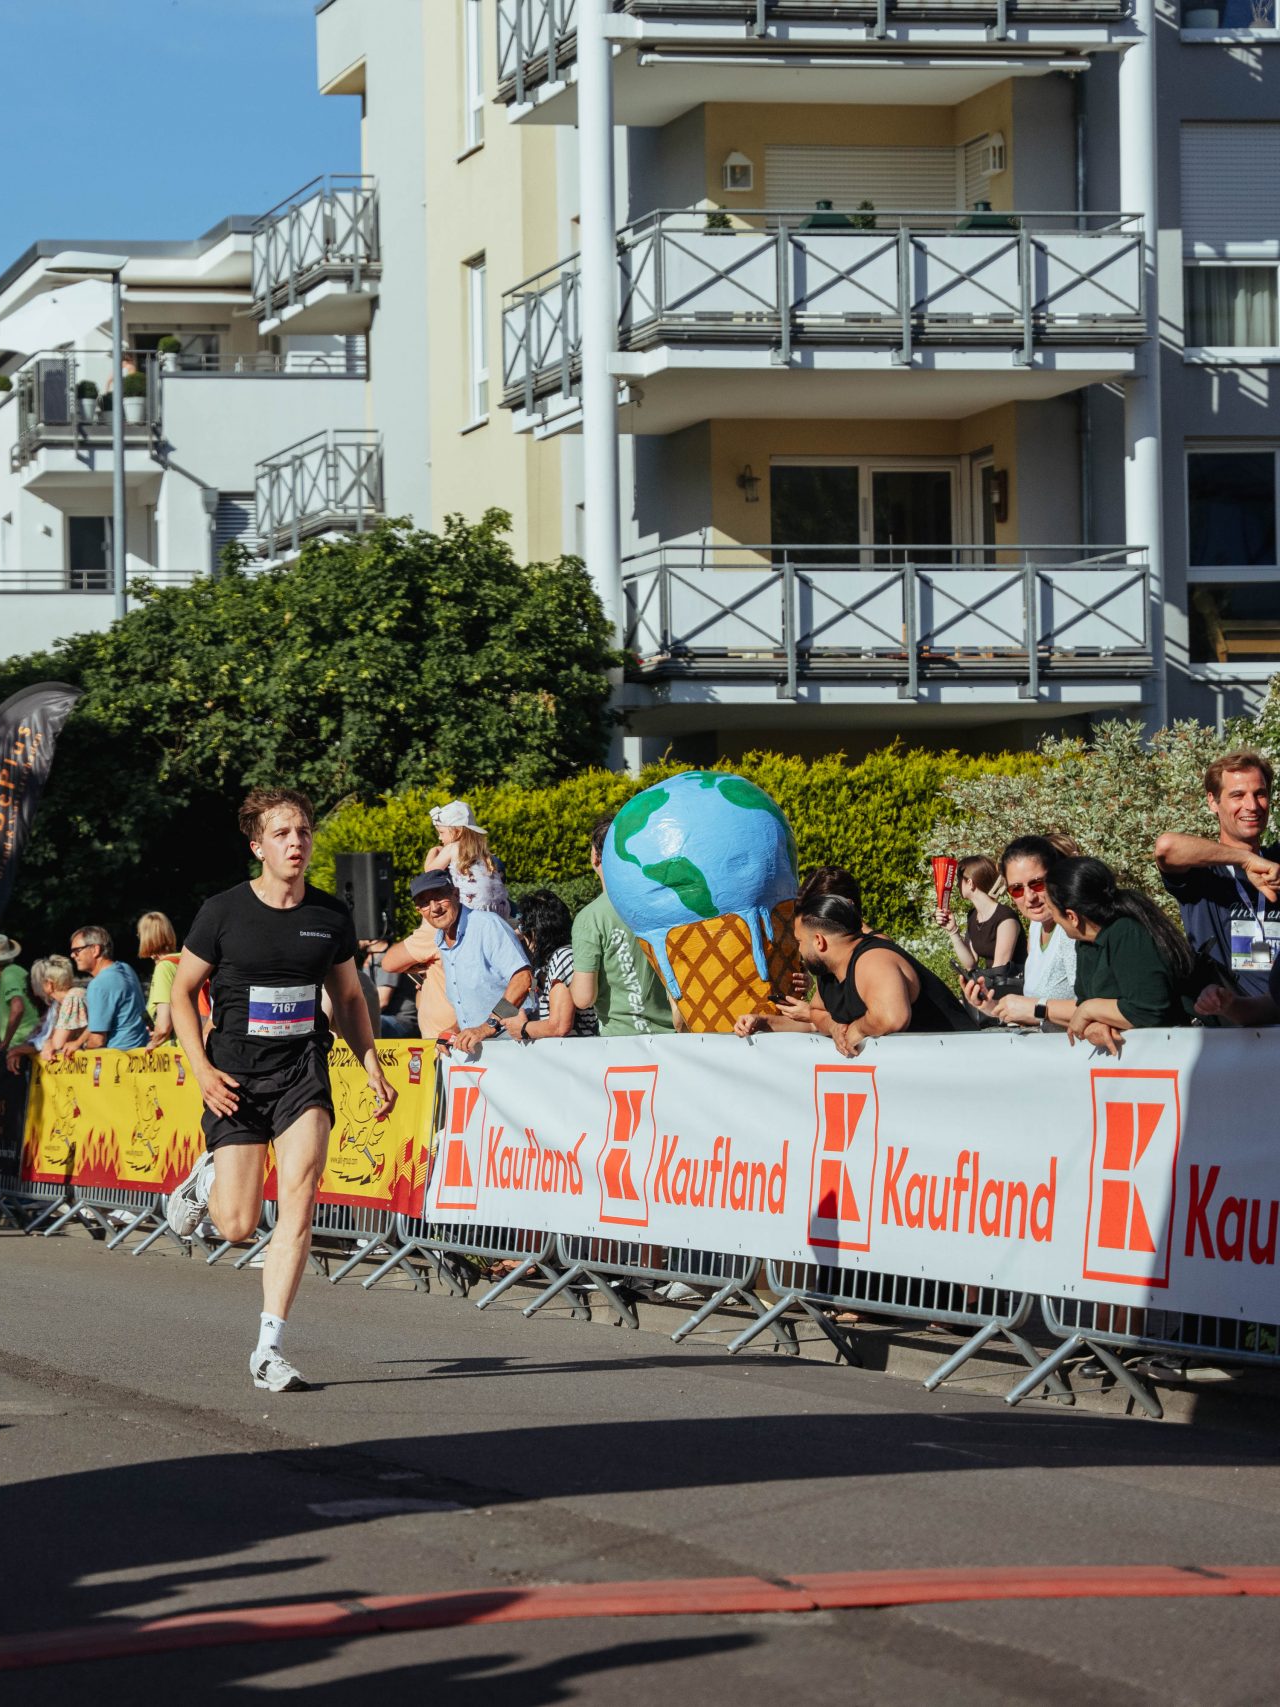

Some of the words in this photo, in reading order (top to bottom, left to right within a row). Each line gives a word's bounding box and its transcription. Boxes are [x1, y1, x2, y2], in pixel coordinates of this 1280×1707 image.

[271, 1003, 297, 1014] 7167
[486, 1127, 586, 1195] Kaufland
[654, 1136, 788, 1214] Kaufland
[882, 1146, 1056, 1242] Kaufland
[1184, 1163, 1280, 1265] Kau
